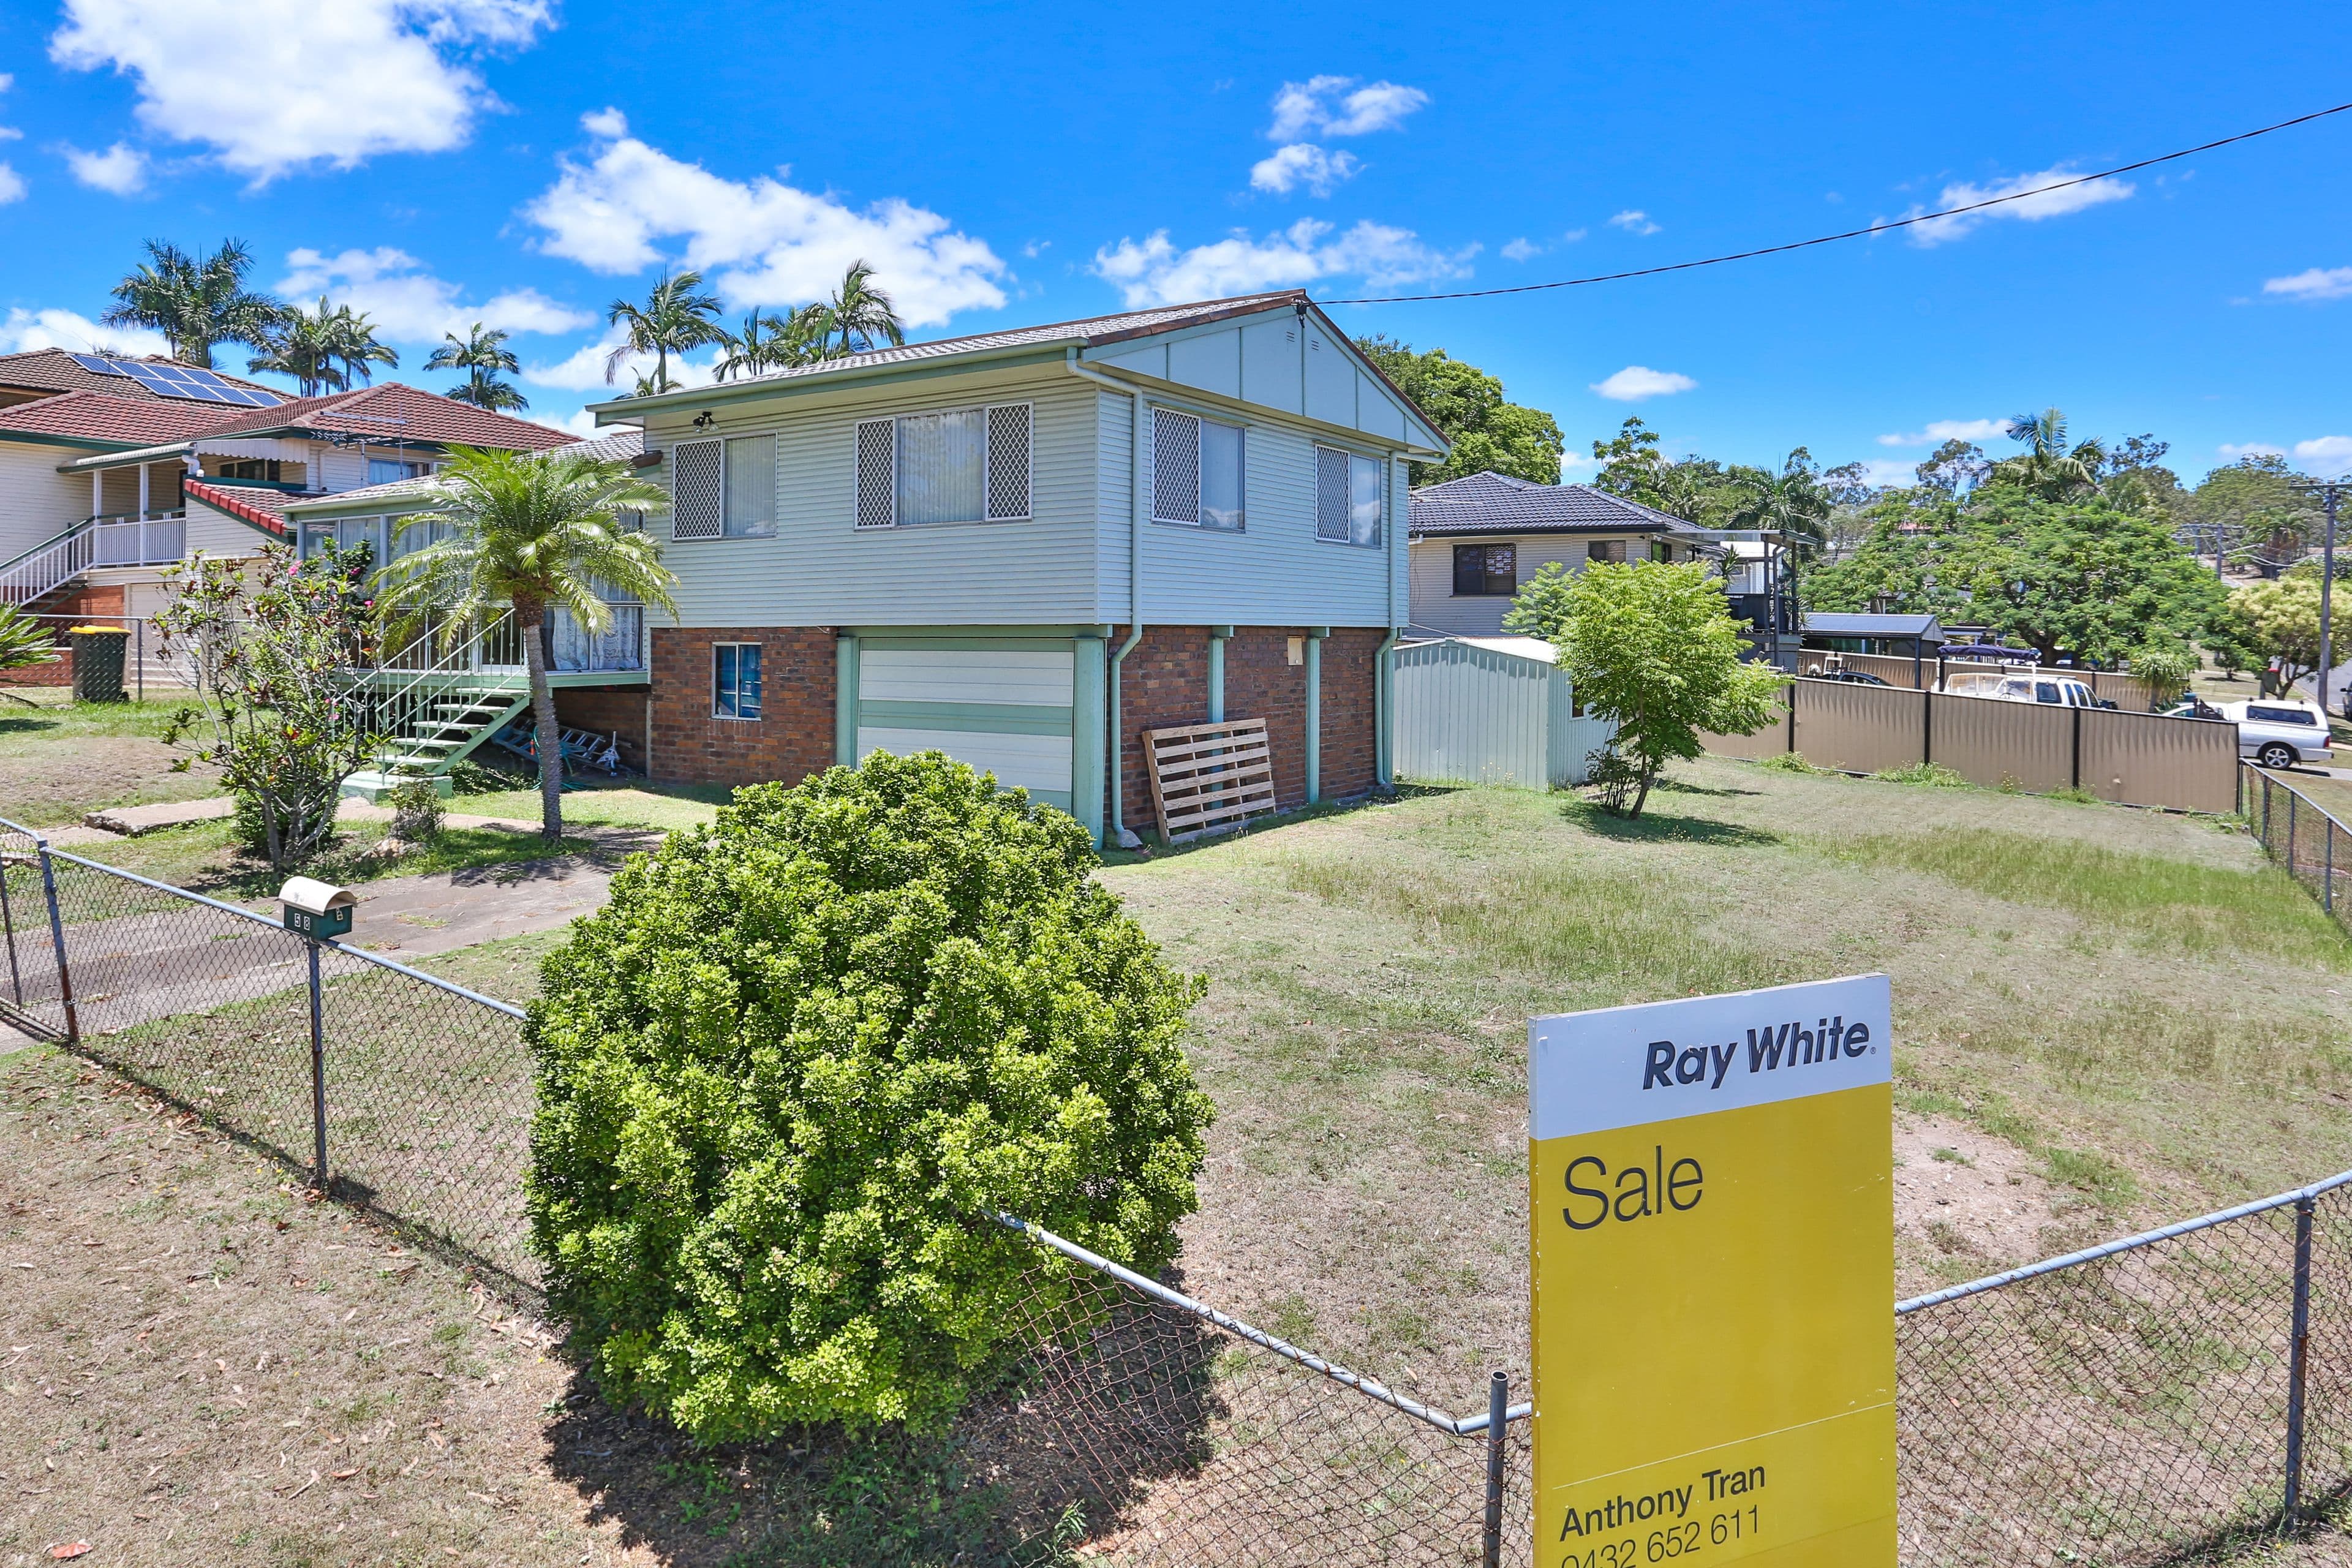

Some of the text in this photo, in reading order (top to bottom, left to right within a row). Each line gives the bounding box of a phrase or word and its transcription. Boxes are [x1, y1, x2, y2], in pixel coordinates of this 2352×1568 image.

[295, 913, 310, 930] 58
[1643, 1016, 1870, 1090] Ray White
[1562, 1145, 1703, 1230] Sale
[1559, 1466, 1765, 1542] Anthony Tran
[1647, 1521, 1700, 1562] 652
[1711, 1504, 1758, 1545] 611
